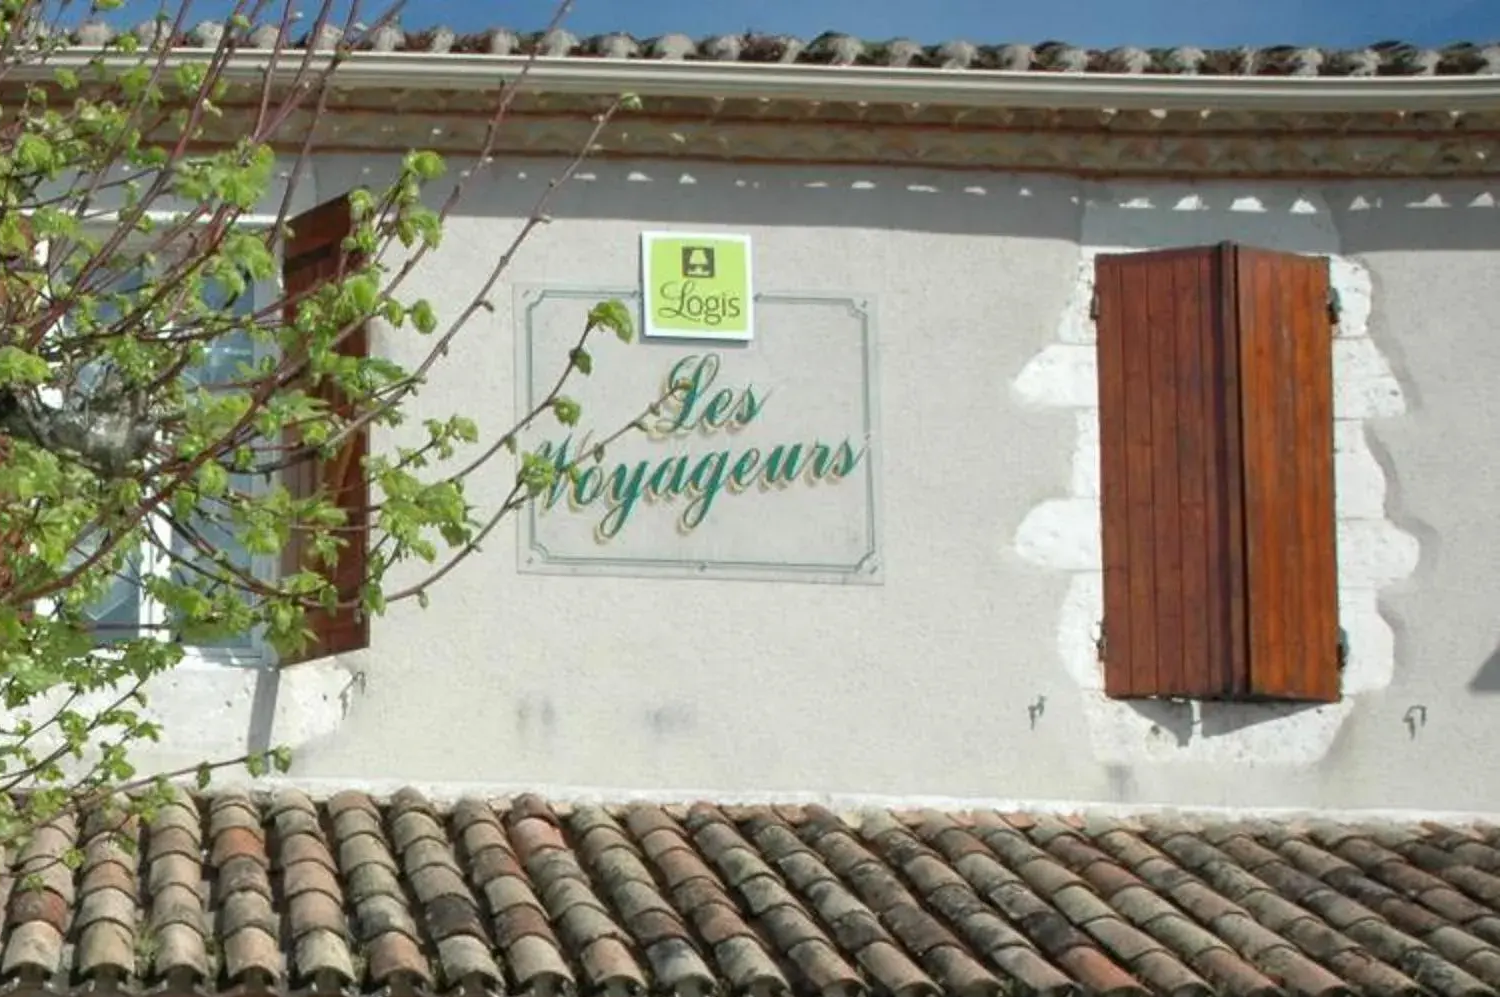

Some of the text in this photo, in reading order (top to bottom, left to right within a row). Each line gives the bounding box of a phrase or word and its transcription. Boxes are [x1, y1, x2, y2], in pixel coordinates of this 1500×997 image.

[657, 280, 741, 325] Logis
[650, 354, 772, 433] Les
[534, 430, 867, 539] Voyageurs
